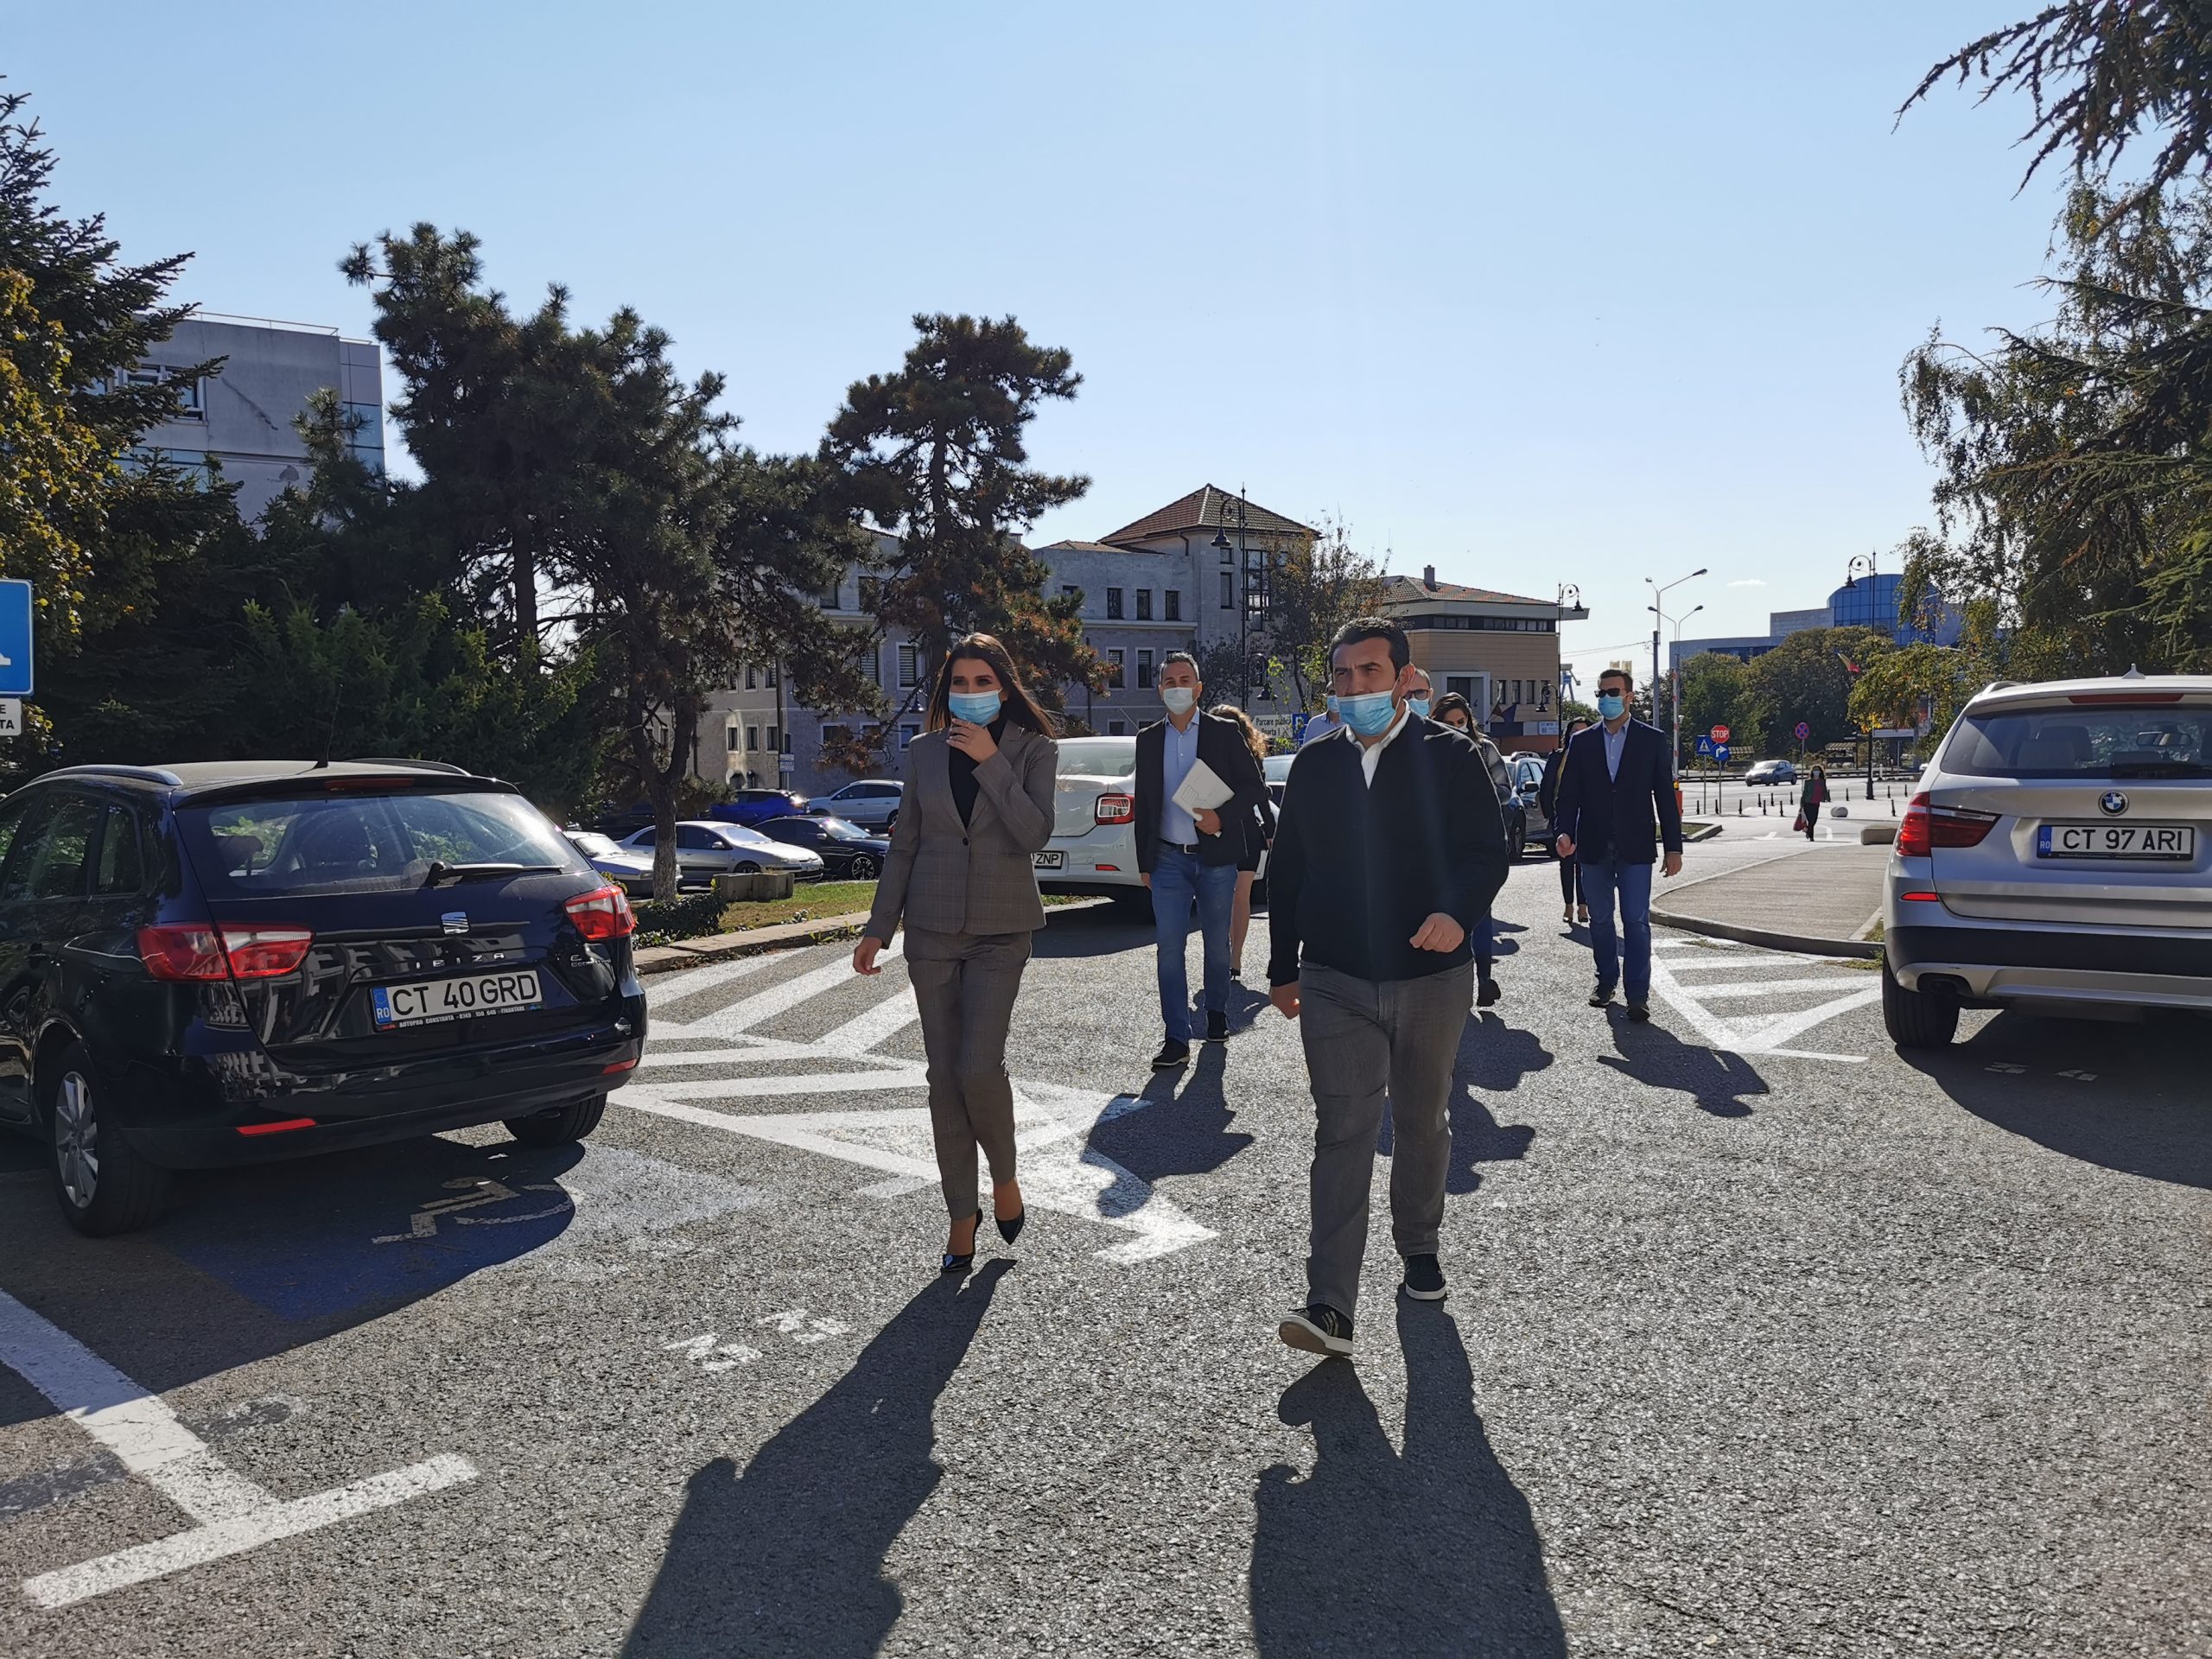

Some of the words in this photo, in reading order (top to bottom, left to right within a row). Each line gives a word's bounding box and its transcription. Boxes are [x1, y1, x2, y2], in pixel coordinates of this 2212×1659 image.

[2063, 829, 2096, 849] CT
[2105, 829, 2136, 849] 97
[2141, 830, 2183, 851] ARI
[1035, 853, 1059, 864] ZNP
[416, 952, 505, 969] IBIZA
[392, 986, 429, 1016] CT
[443, 981, 476, 1008] 40
[479, 974, 537, 1004] GRD
[376, 1007, 390, 1020] RO
[399, 1020, 423, 1028] AUTOPRO
[425, 1014, 454, 1024] CONSTANTA
